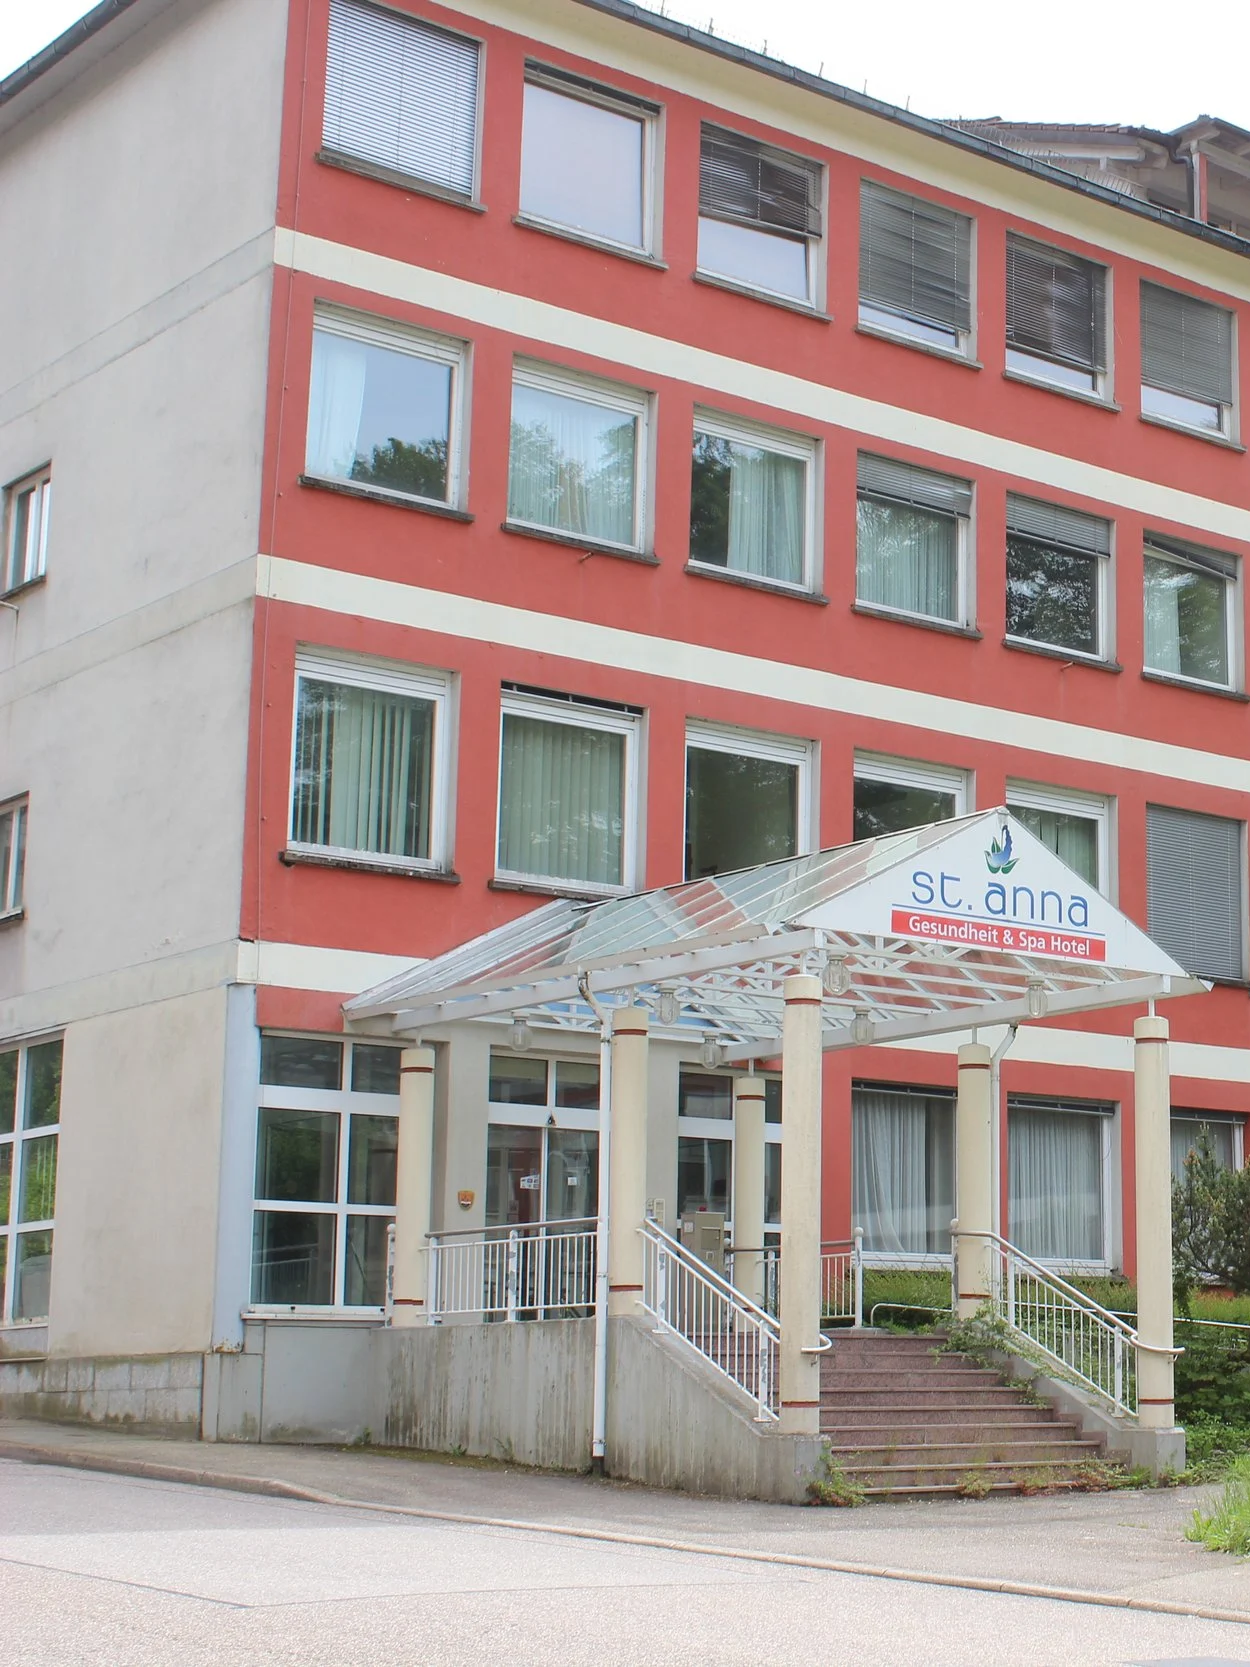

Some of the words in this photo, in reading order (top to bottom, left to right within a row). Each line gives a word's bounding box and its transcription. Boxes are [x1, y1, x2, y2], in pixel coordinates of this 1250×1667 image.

[911, 871, 973, 911] st.
[984, 881, 1089, 928] anna
[908, 916, 999, 944] Gesundheit
[1002, 930, 1014, 945] &
[1018, 932, 1046, 950] Spa
[1050, 937, 1090, 956] Hotel
